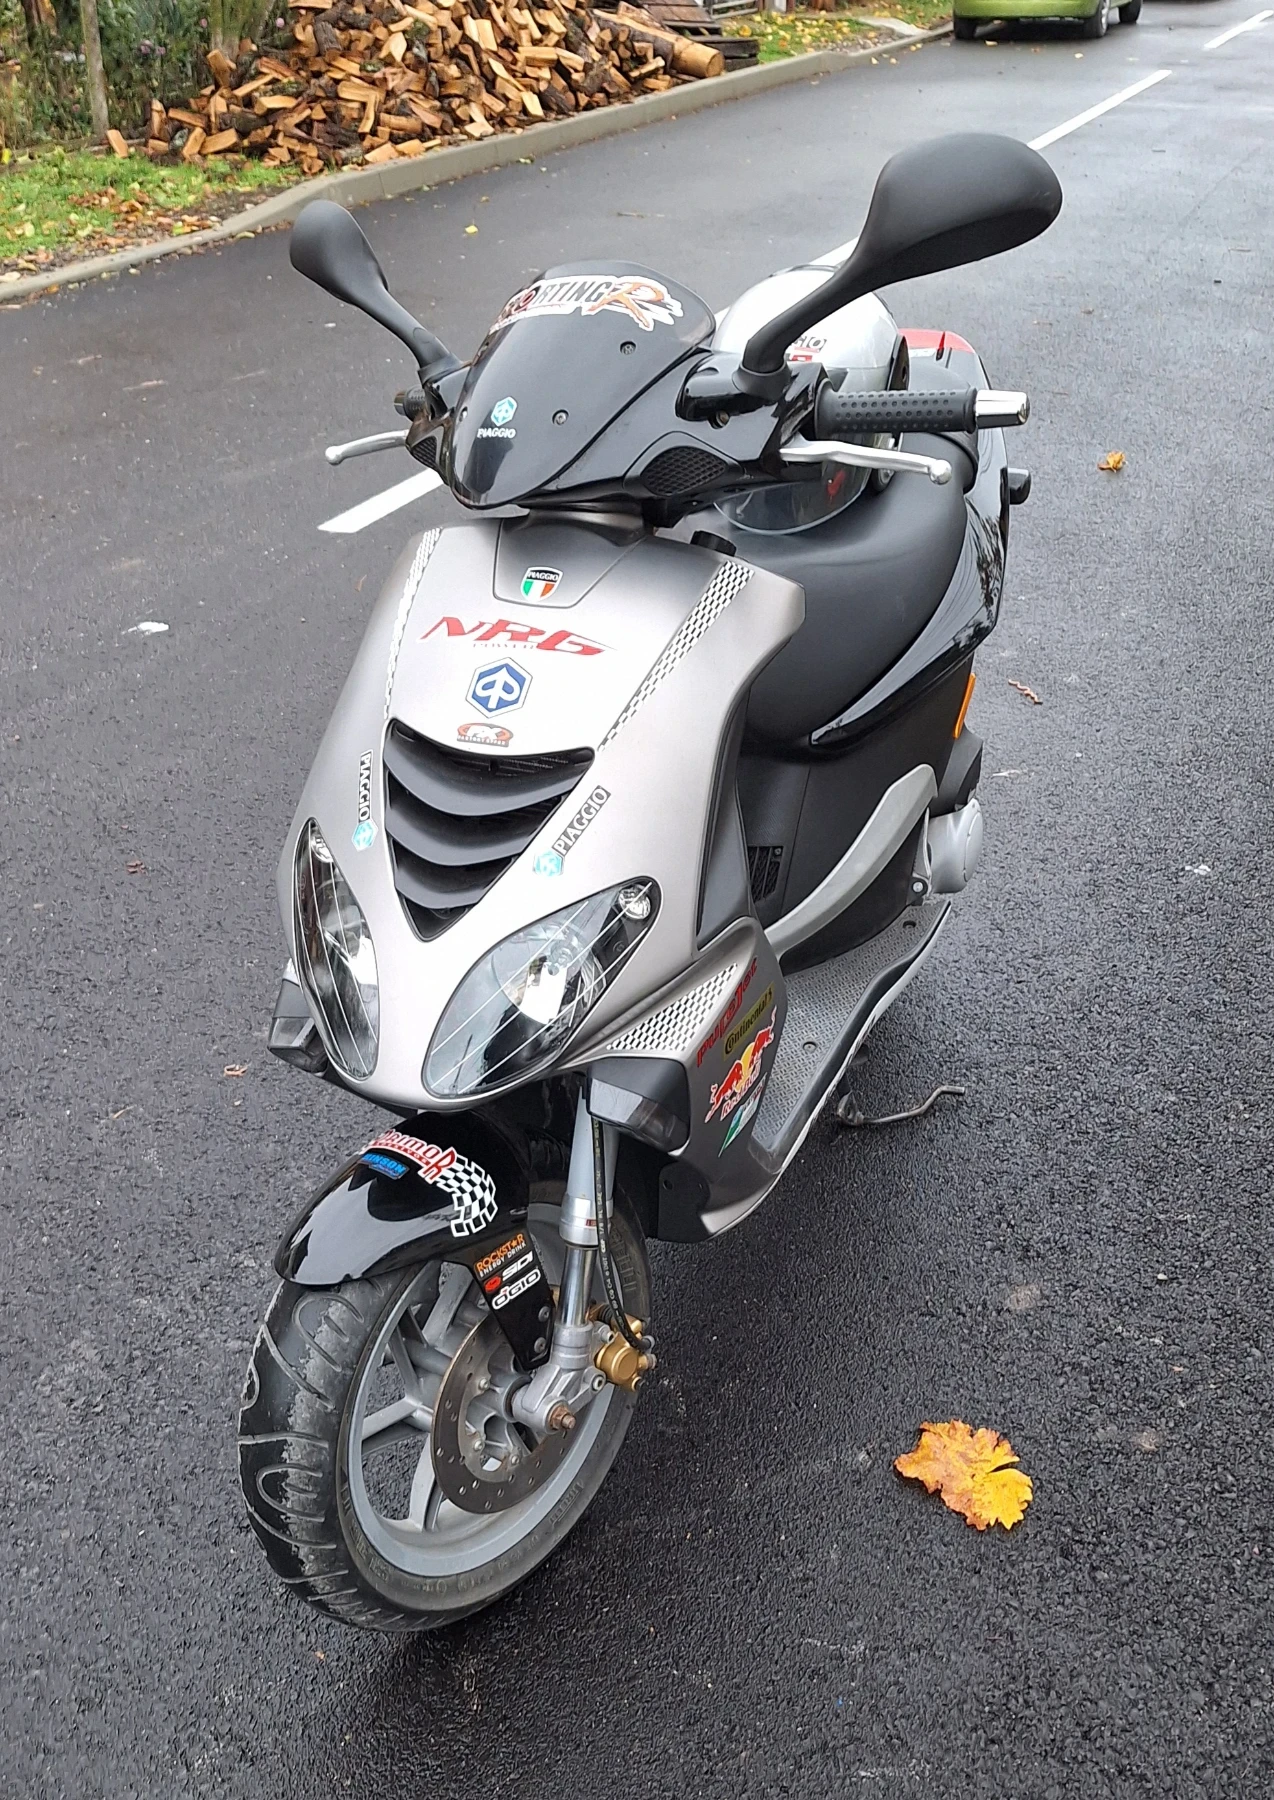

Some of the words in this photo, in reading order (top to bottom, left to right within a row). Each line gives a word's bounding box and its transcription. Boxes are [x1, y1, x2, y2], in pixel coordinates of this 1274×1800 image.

[477, 427, 517, 438] PIAGGIO
[527, 570, 560, 581] PIAGGIO
[420, 616, 606, 656] NRG
[359, 752, 372, 821] PIAGGIO
[552, 787, 609, 856] PIAGGIO
[479, 1256, 505, 1278] ENERGY
